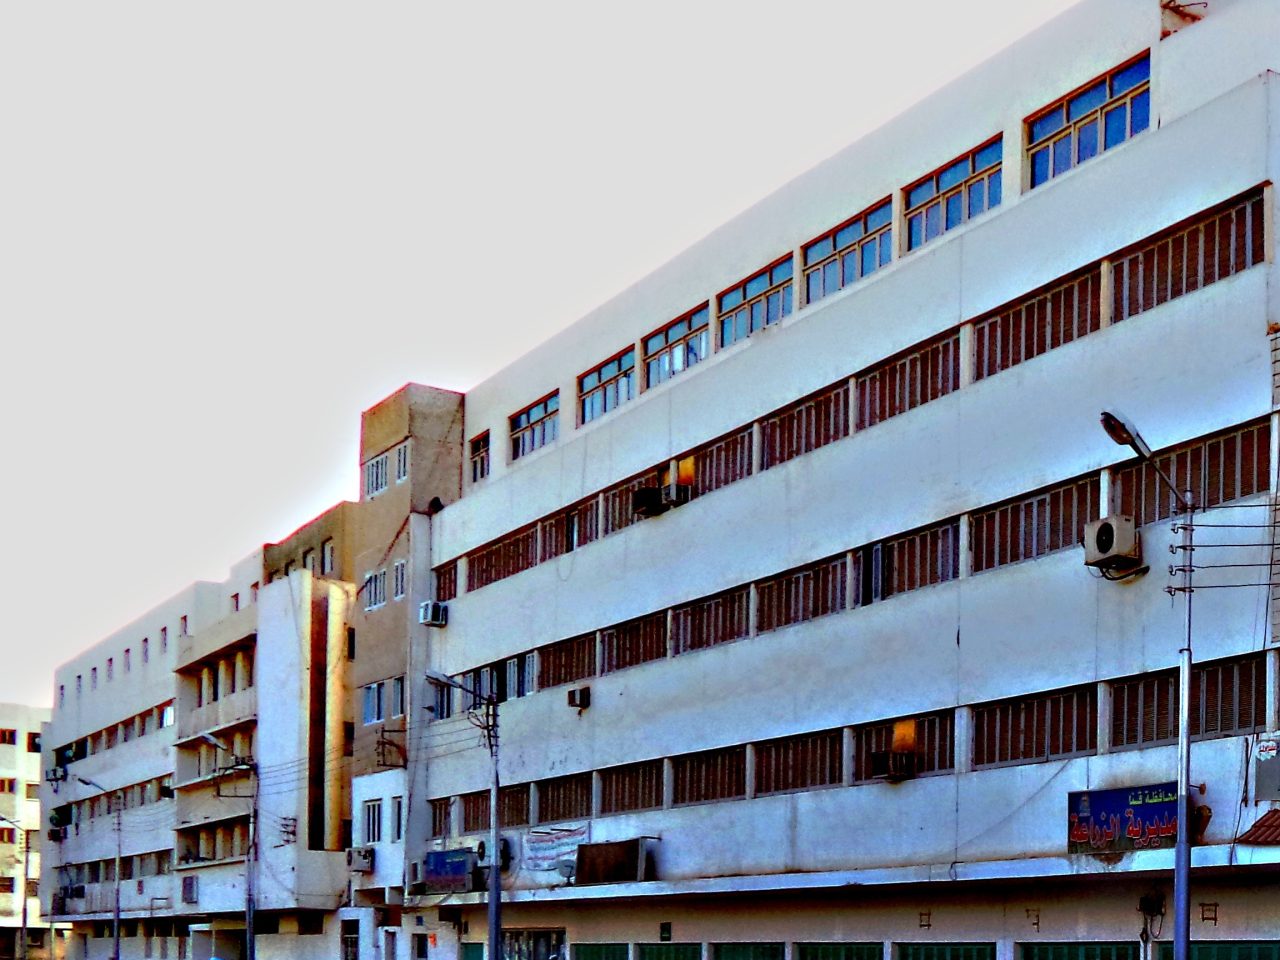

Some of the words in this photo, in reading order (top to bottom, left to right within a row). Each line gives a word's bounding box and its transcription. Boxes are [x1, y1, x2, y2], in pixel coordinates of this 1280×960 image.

[1129, 791, 1142, 805] قنا
[1145, 790, 1177, 803] محافظة
[1070, 811, 1120, 848] الزراعة
[1125, 808, 1178, 848] مديرية
